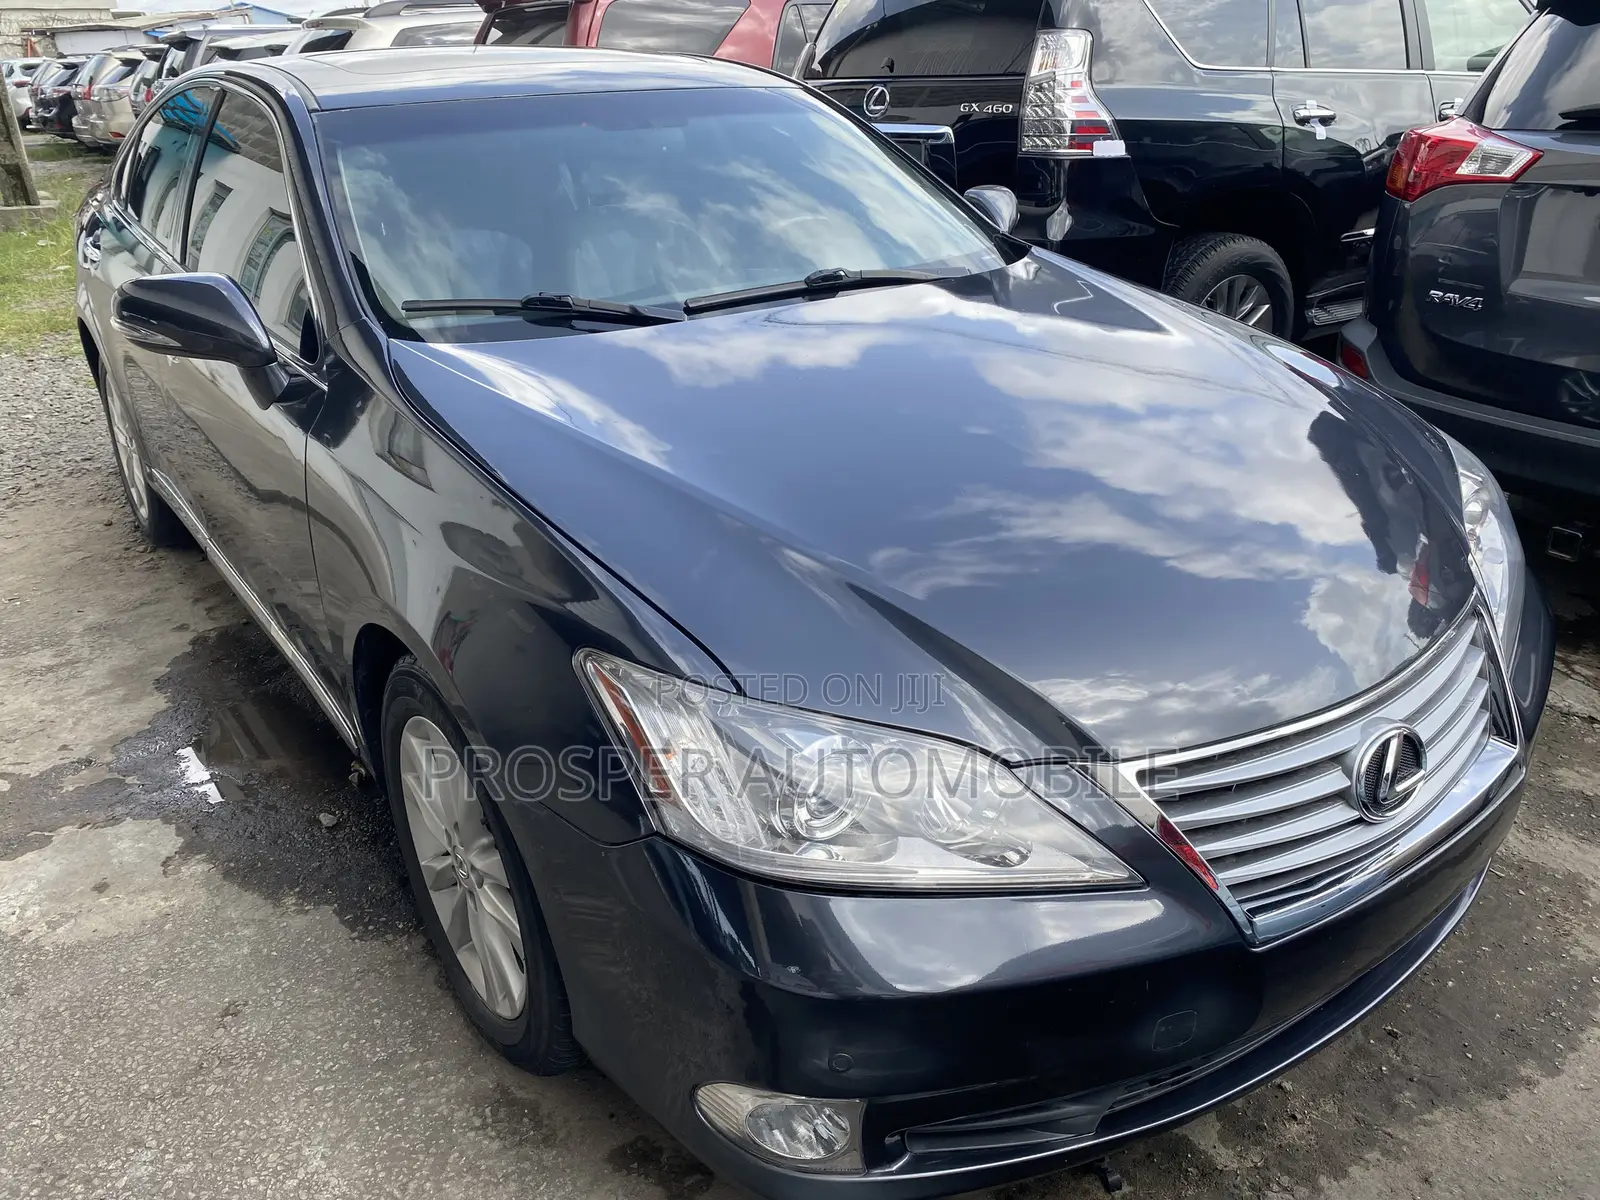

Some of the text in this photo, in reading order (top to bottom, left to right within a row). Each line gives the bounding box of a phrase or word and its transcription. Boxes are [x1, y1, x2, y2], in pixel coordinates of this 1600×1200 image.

[960, 102, 1013, 113] GX 460
[1426, 289, 1484, 311] RAV4
